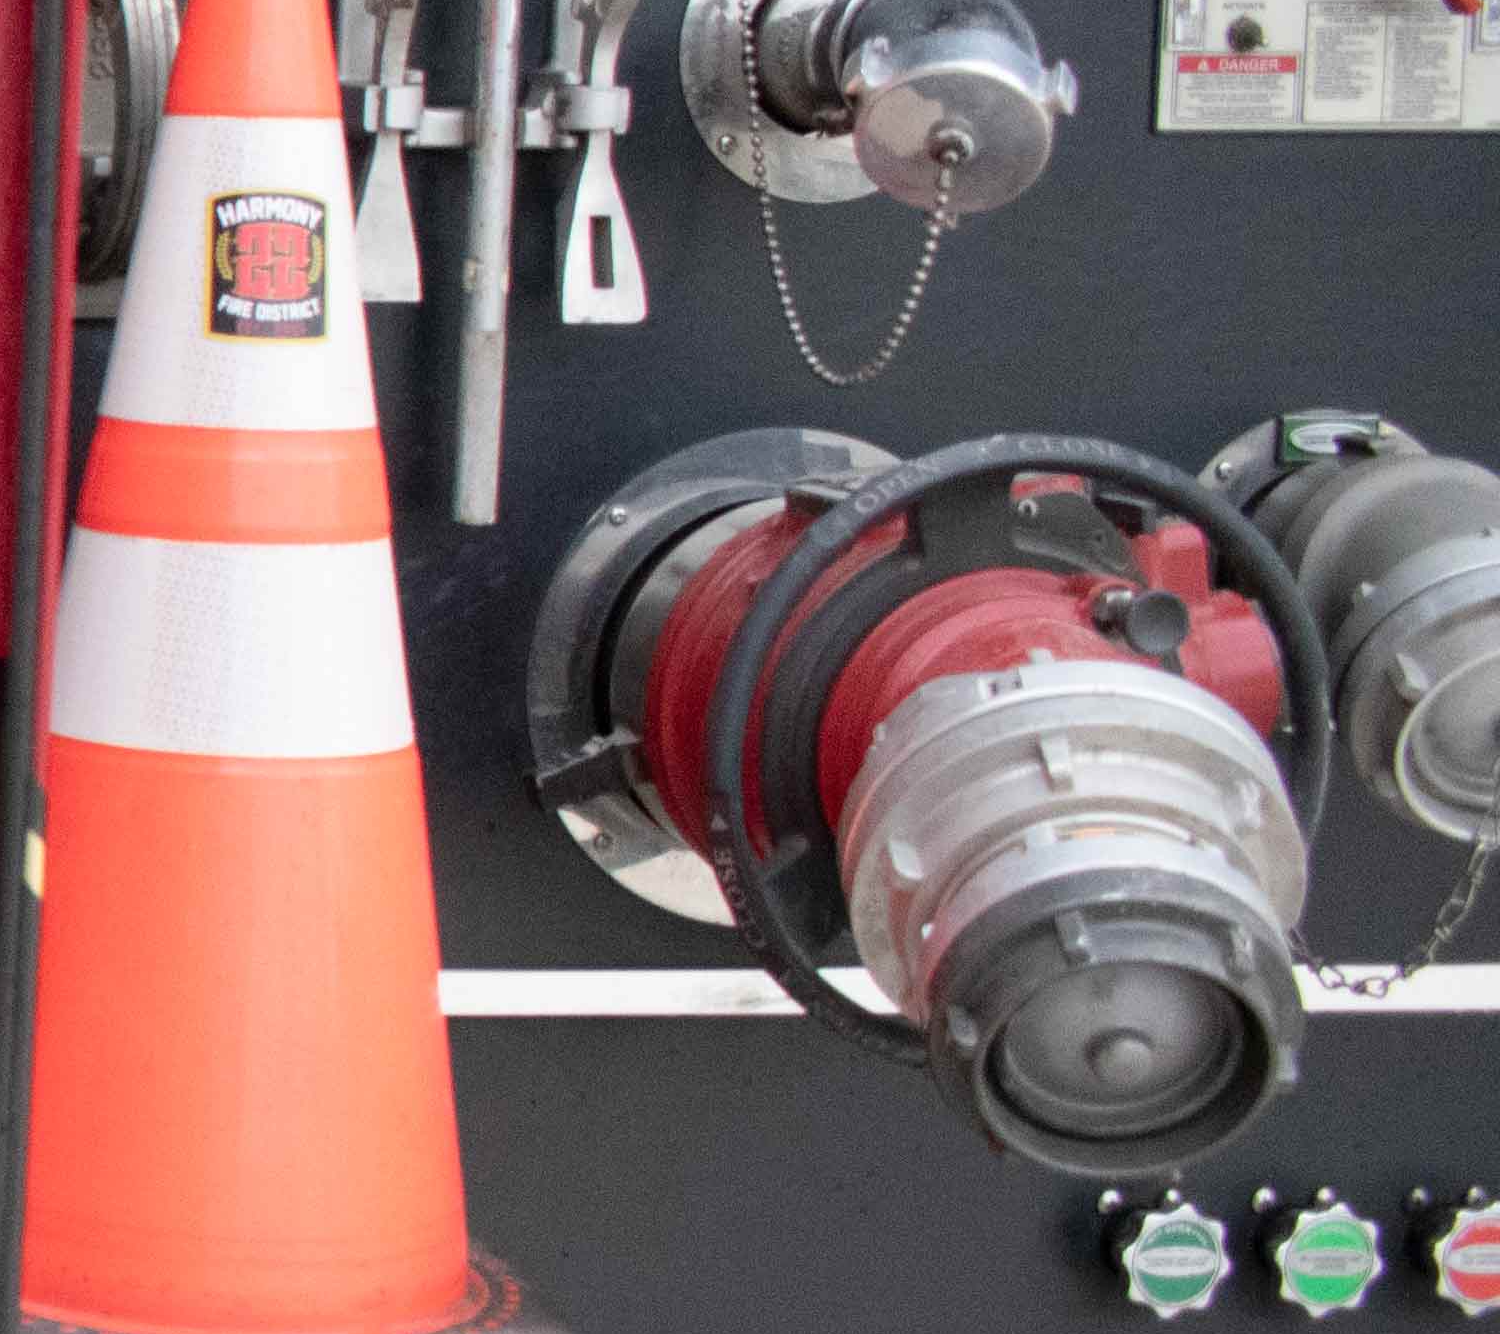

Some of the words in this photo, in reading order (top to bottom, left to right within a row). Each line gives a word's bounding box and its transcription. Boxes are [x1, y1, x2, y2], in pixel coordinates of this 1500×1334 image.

[1219, 57, 1278, 74] DANGER
[216, 196, 323, 228] HARMONY
[235, 221, 312, 299] 22
[217, 294, 255, 319] FIRE
[254, 296, 323, 322] DISTRICT
[853, 452, 942, 515] OPEN
[1018, 436, 1124, 465] CLOSE
